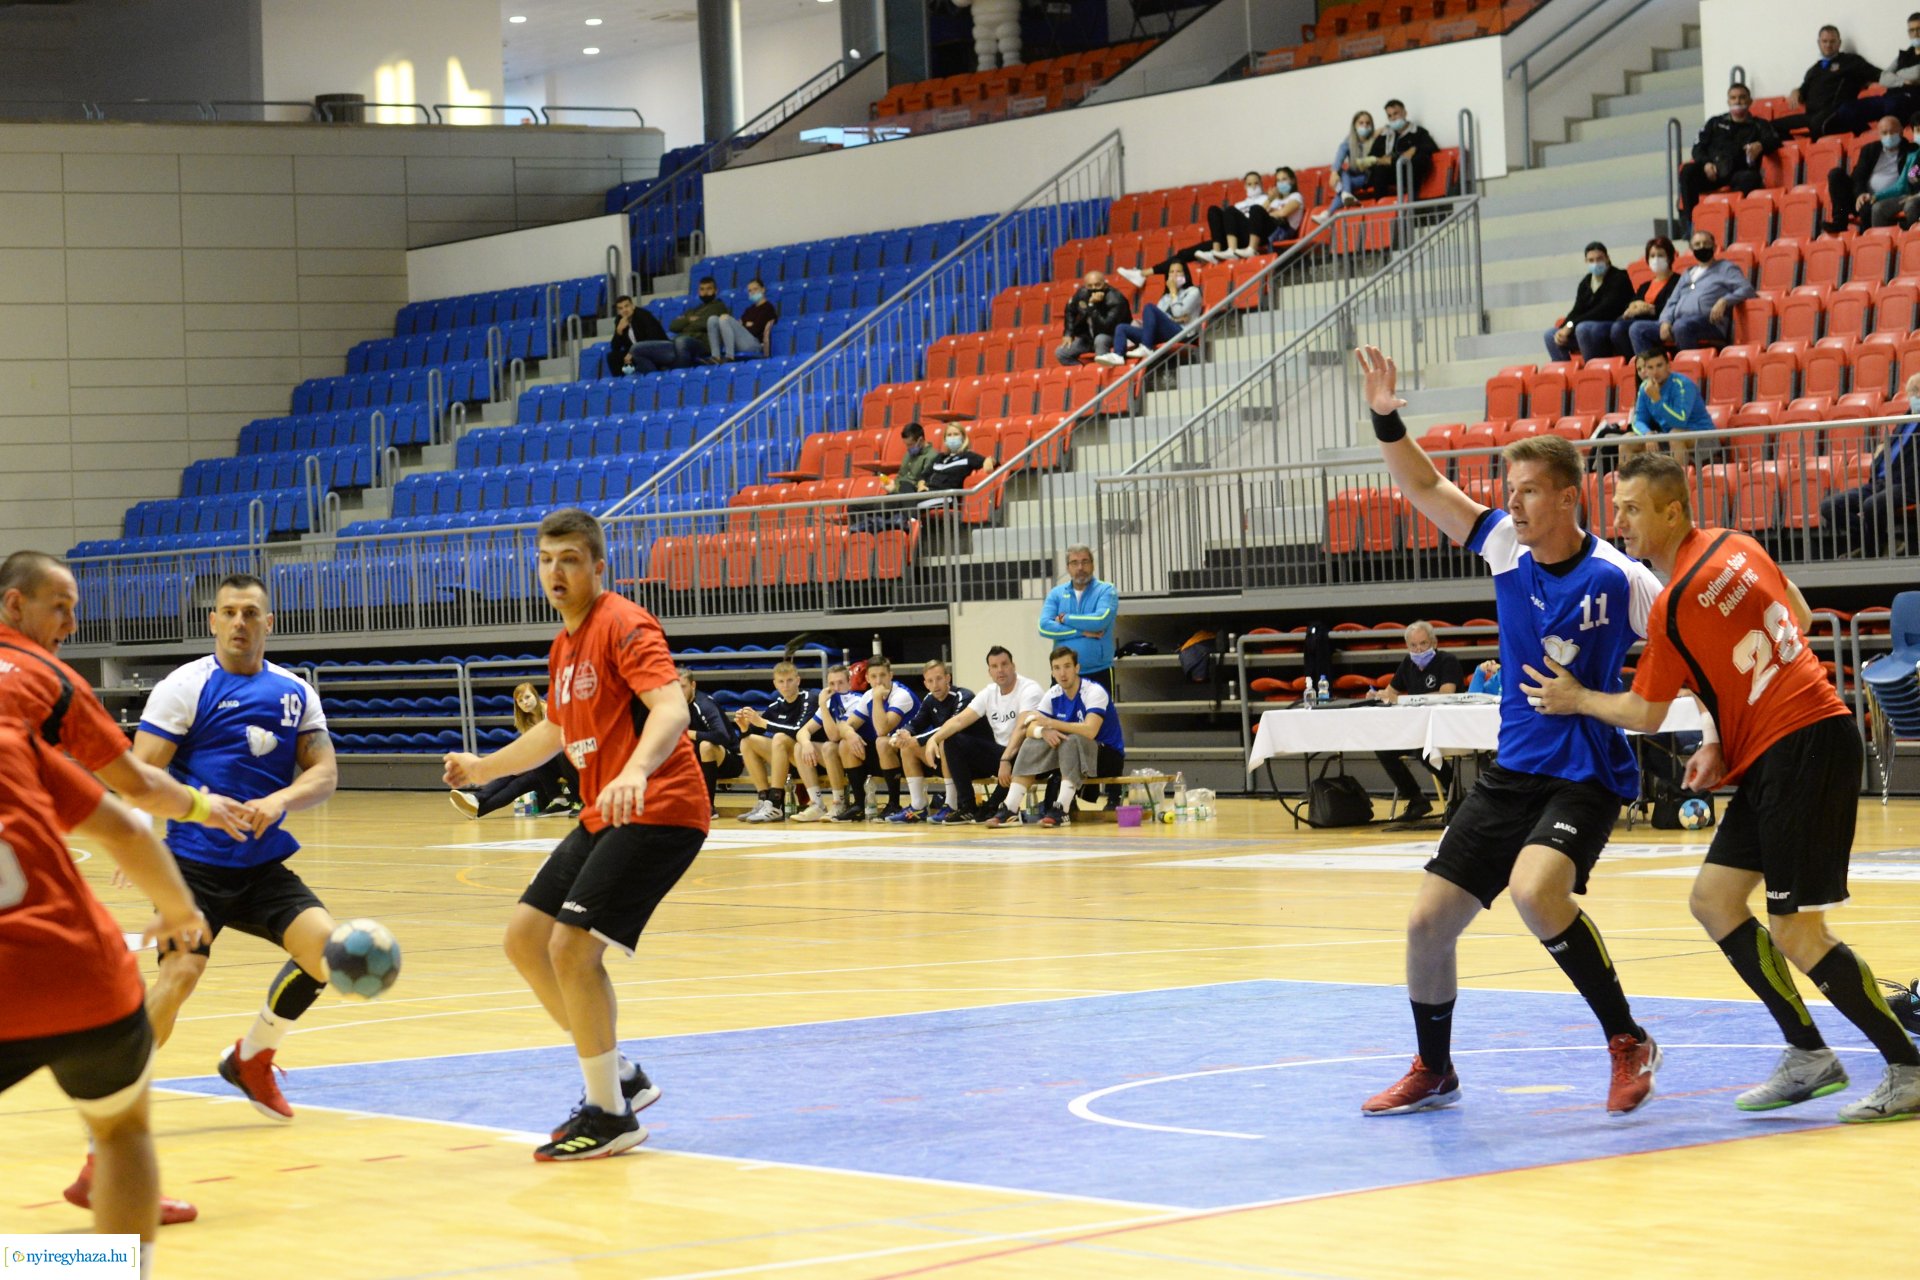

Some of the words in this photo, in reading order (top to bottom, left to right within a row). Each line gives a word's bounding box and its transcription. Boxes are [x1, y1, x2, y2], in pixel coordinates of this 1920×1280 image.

[1697, 566, 1736, 608] Optimum
[1718, 579, 1748, 617] Békési
[1579, 592, 1609, 631] 11
[280, 693, 302, 728] 19
[1553, 821, 1578, 835] JAKO
[1766, 890, 1791, 900] aller
